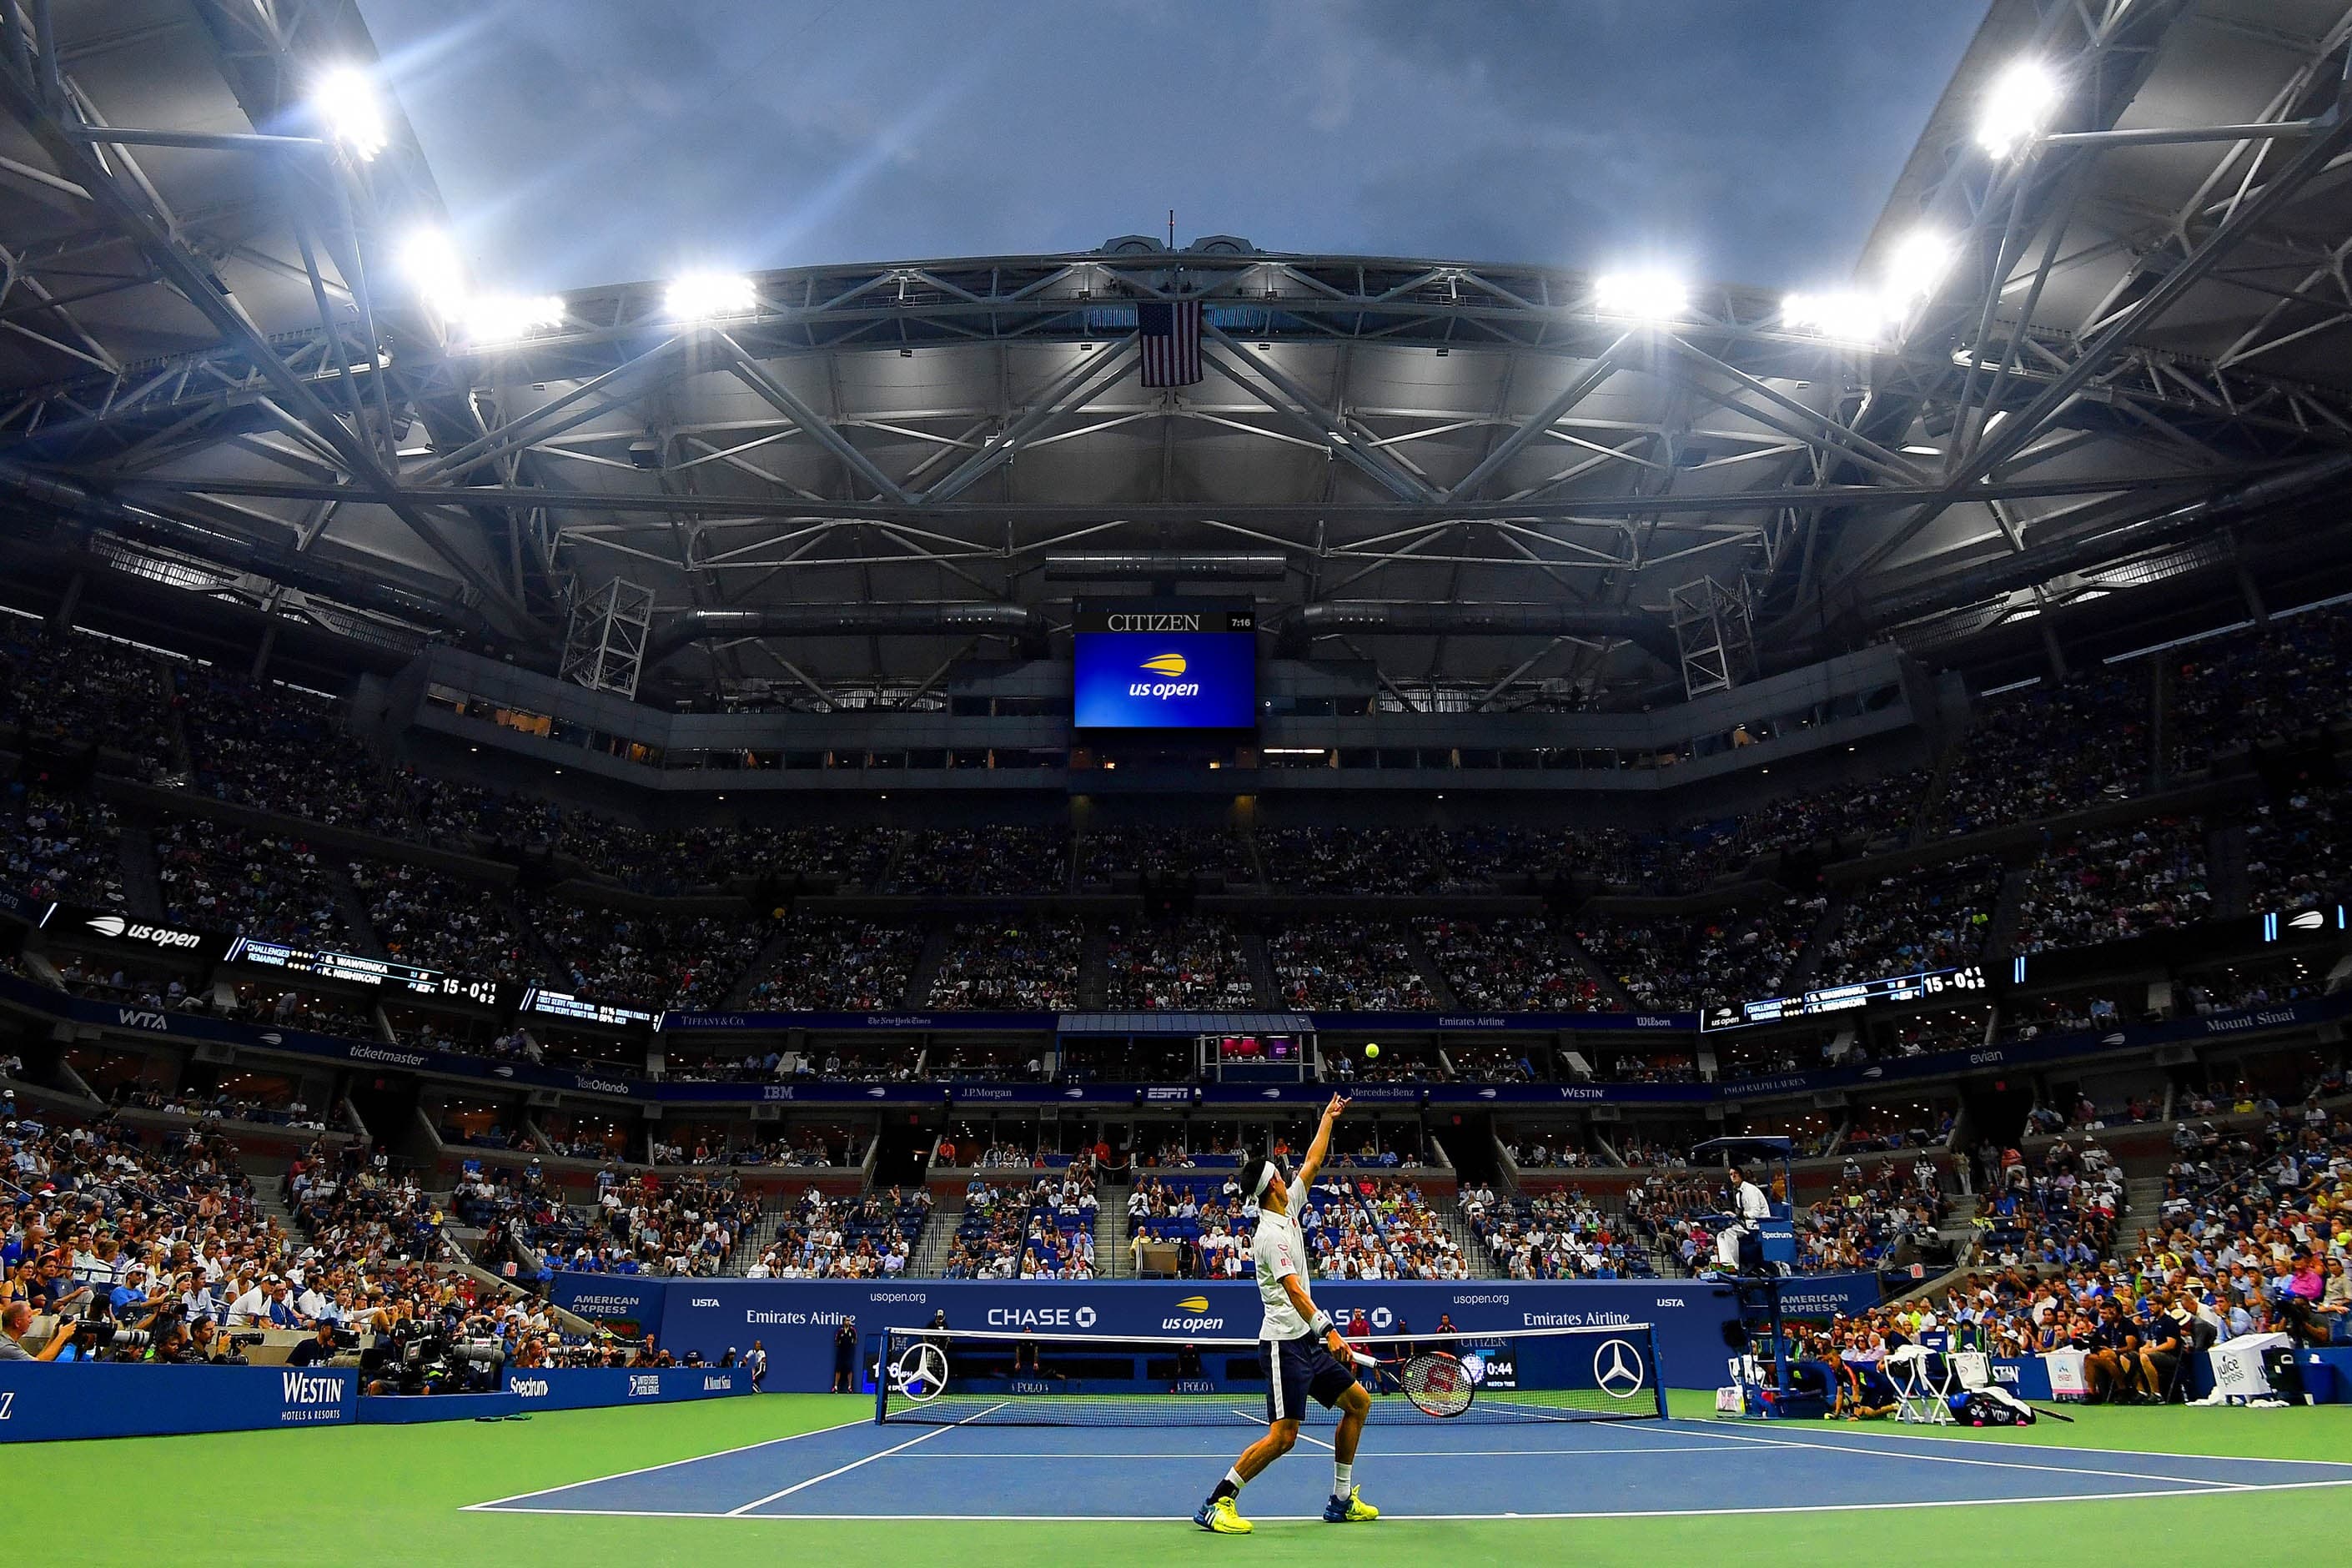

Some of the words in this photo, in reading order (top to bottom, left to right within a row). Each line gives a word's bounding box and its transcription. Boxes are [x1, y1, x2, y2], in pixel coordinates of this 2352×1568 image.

[1108, 615, 1200, 632] CITIZEN
[1231, 619, 1252, 627] 7:16
[1129, 683, 1151, 696] us
[1153, 683, 1199, 701] open
[127, 924, 154, 939] us
[151, 928, 201, 948] open
[119, 1008, 167, 1030] WTA
[681, 1015, 720, 1026] TIFFANY
[867, 1017, 880, 1025] The
[880, 1017, 894, 1025] New
[894, 1017, 911, 1026] York
[911, 1017, 932, 1025] Times
[1439, 1017, 1475, 1027] Emirates
[1476, 1017, 1505, 1027] Airline
[1636, 1017, 1672, 1027] Wilson
[1721, 1016, 1740, 1027] open
[2206, 1015, 2254, 1033] Mount
[2256, 1008, 2296, 1025] Sinai
[349, 1044, 425, 1066] ticketmaster
[1970, 1049, 2004, 1064] evian
[763, 1085, 794, 1099] IBM
[1147, 1088, 1189, 1099] ESPN
[1350, 1088, 1415, 1098] Mercedes-Benz
[1560, 1088, 1604, 1098] WESTIN
[1761, 1231, 1793, 1240] Spectrum
[574, 1295, 640, 1305] AMERICAN
[691, 1299, 721, 1307] USTA
[869, 1293, 927, 1304] usopen.org
[1453, 1294, 1510, 1305] usopen.org
[1656, 1299, 1686, 1307] USTA
[1780, 1294, 1849, 1304] AMERICAN
[572, 1304, 627, 1314] EXPRESS
[1780, 1303, 1838, 1313] EXPRESS
[746, 1309, 807, 1324] Emirates
[988, 1309, 1071, 1326] CHASE
[1523, 1312, 1582, 1326] Emirates
[1586, 1312, 1631, 1326] Airline
[1162, 1318, 1182, 1329] us
[1182, 1318, 1224, 1333] open
[1486, 1362, 1513, 1375] 0:44
[2216, 1355, 2240, 1379] juice
[282, 1372, 343, 1404] WESTIN
[510, 1376, 549, 1398] Spectrum
[1017, 1382, 1043, 1393] POLO
[1184, 1381, 1209, 1393] POLO
[281, 1411, 306, 1421] HOTELS
[314, 1409, 340, 1420] RESORTS
